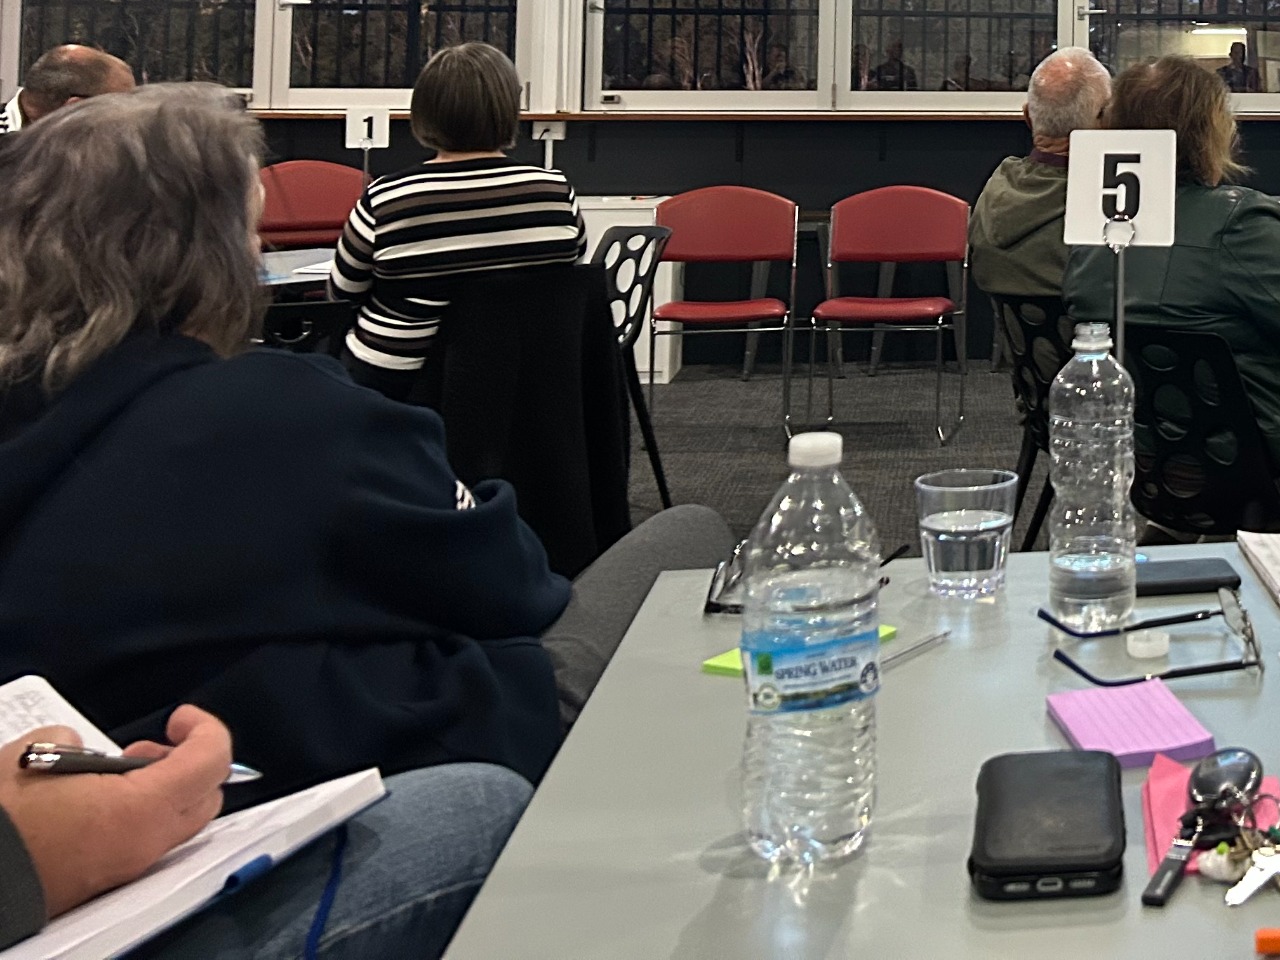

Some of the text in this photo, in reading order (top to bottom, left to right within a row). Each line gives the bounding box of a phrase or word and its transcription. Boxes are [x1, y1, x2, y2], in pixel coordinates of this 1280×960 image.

[362, 116, 373, 139] 1
[1102, 153, 1141, 221] 5
[774, 656, 857, 679] SPRING WATER
